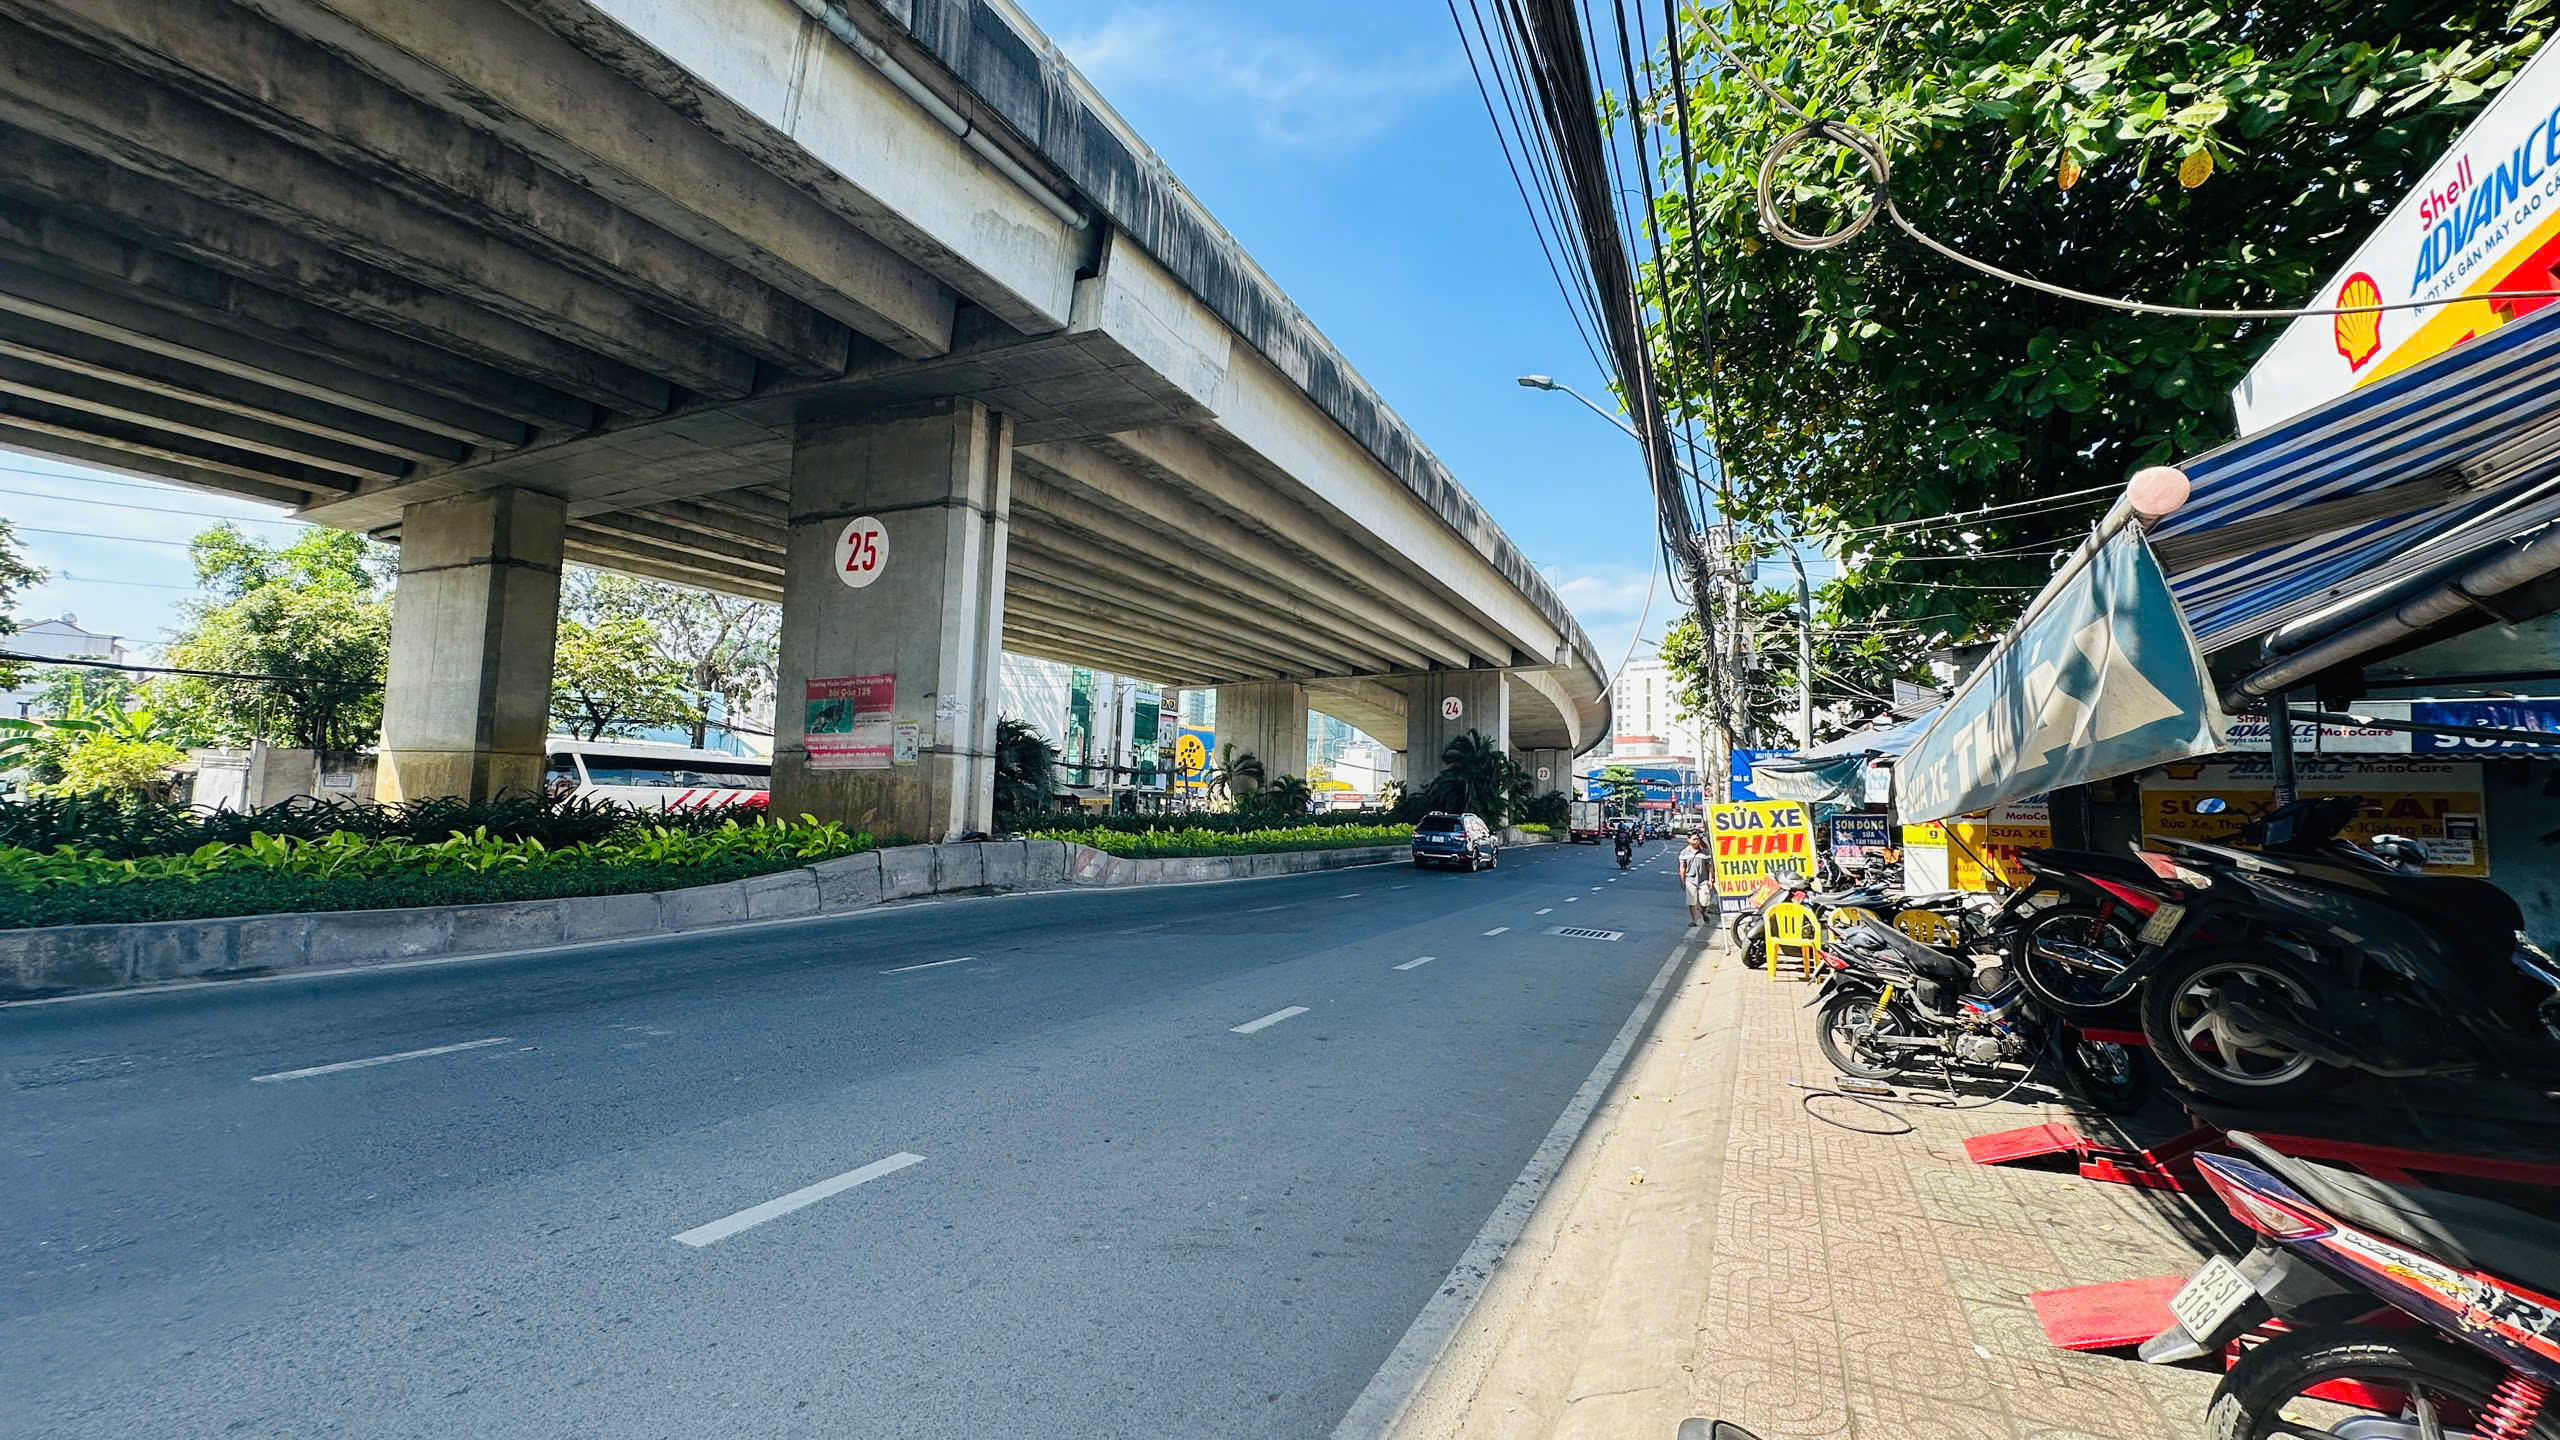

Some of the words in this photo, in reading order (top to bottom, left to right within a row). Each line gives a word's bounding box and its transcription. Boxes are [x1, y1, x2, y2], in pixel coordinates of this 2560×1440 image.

[2419, 153, 2473, 232] Shell
[2442, 270, 2457, 291] XE
[2514, 194, 2542, 226] CAO
[846, 531, 878, 571] 25
[858, 687, 871, 696] 125
[1445, 701, 1459, 715] 24
[1928, 754, 1949, 807] XE
[1953, 616, 2184, 794] THÁI
[2225, 724, 2318, 737] ADVACE
[2320, 727, 2393, 737] MotoCare
[1539, 769, 1548, 778] 23
[2358, 762, 2454, 773] MotoCare
[1715, 806, 1764, 831] SỬA
[1769, 808, 1803, 828] XE
[2006, 811, 2048, 820] MotoCa
[2217, 818, 2243, 830] Tha
[2360, 822, 2417, 837] Không
[1929, 830, 1939, 840] 9
[2027, 828, 2048, 839] XE
[1716, 830, 1804, 856] THÁI
[1720, 859, 1759, 875] THAY
[1764, 855, 1807, 874] NHỚT
[2177, 1287, 2218, 1331] 3199
